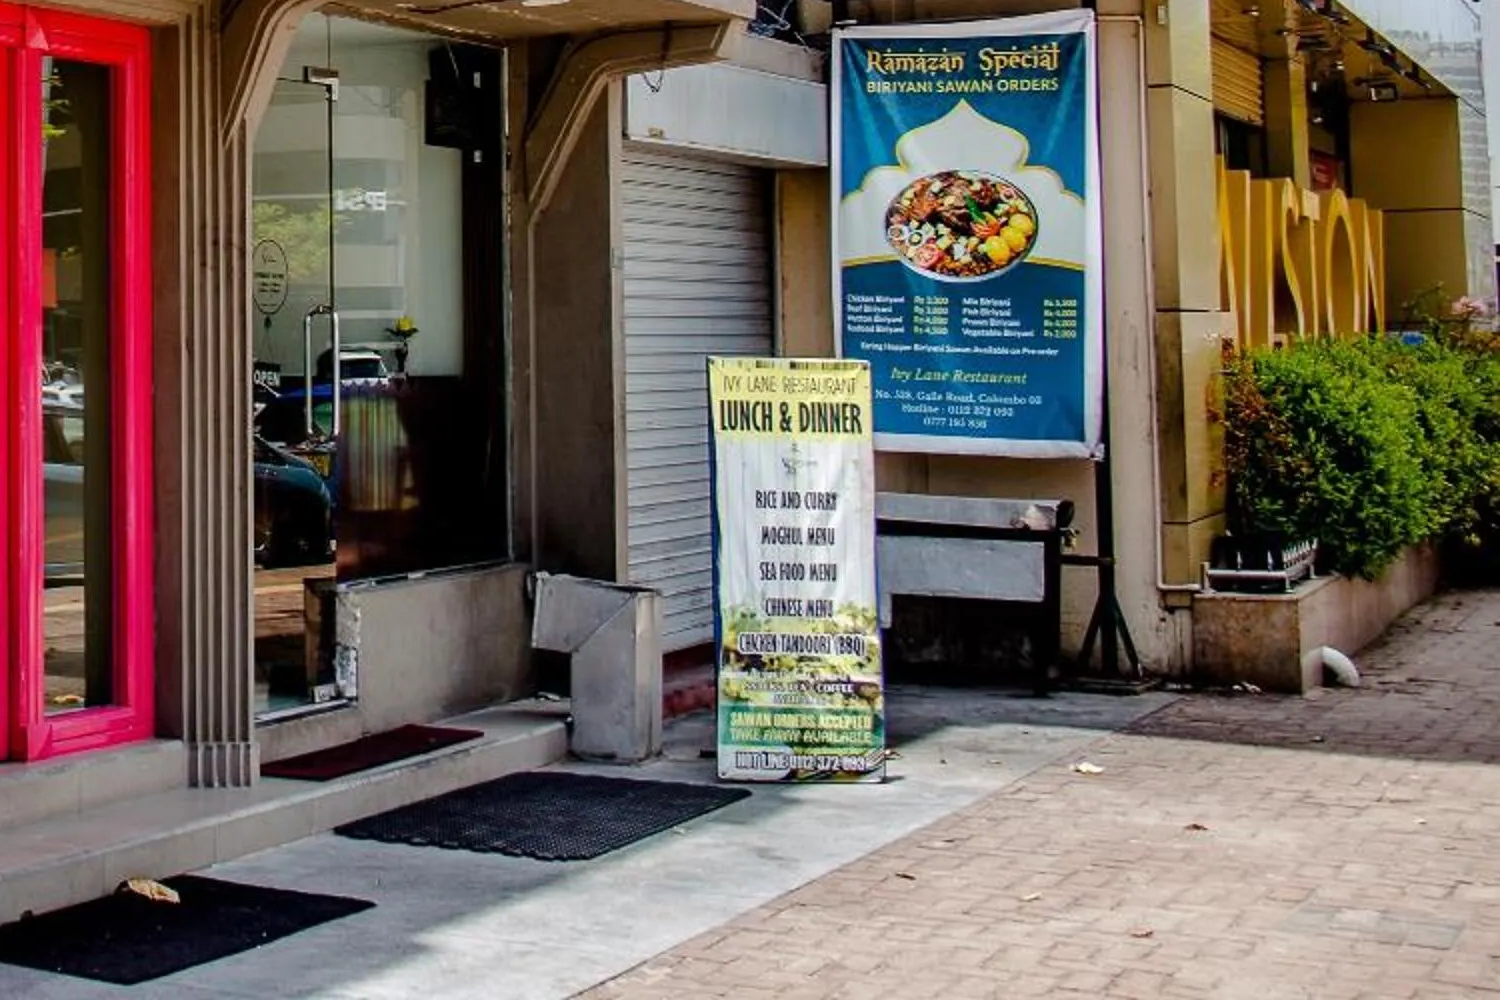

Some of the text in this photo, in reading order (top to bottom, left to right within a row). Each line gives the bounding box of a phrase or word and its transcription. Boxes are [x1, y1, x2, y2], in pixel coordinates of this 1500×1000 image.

[866, 41, 1061, 77] Ramazan Special
[866, 77, 1059, 94] BIRIYANI SAWAN ORDERS
[254, 369, 281, 387] OPEN
[723, 375, 858, 395] IVY LANE RESTAURANT
[891, 367, 1028, 385] Ivy Lane Restaurant
[978, 393, 1027, 405] Colombo
[719, 399, 863, 434] LUNCH & DINNER
[755, 489, 838, 511] RICE AND CURRY
[761, 526, 835, 546] MOGHUL MENU
[759, 561, 837, 582] SEA FOOD MENU
[765, 597, 833, 618] CHINESE MENU
[739, 633, 866, 656] CHICKEN TANDOORI (BBQ)
[817, 683, 855, 693] COFFEE
[819, 714, 872, 730] ACCEPTED
[730, 727, 761, 742] TAKE
[803, 730, 873, 744] AVAILABLE
